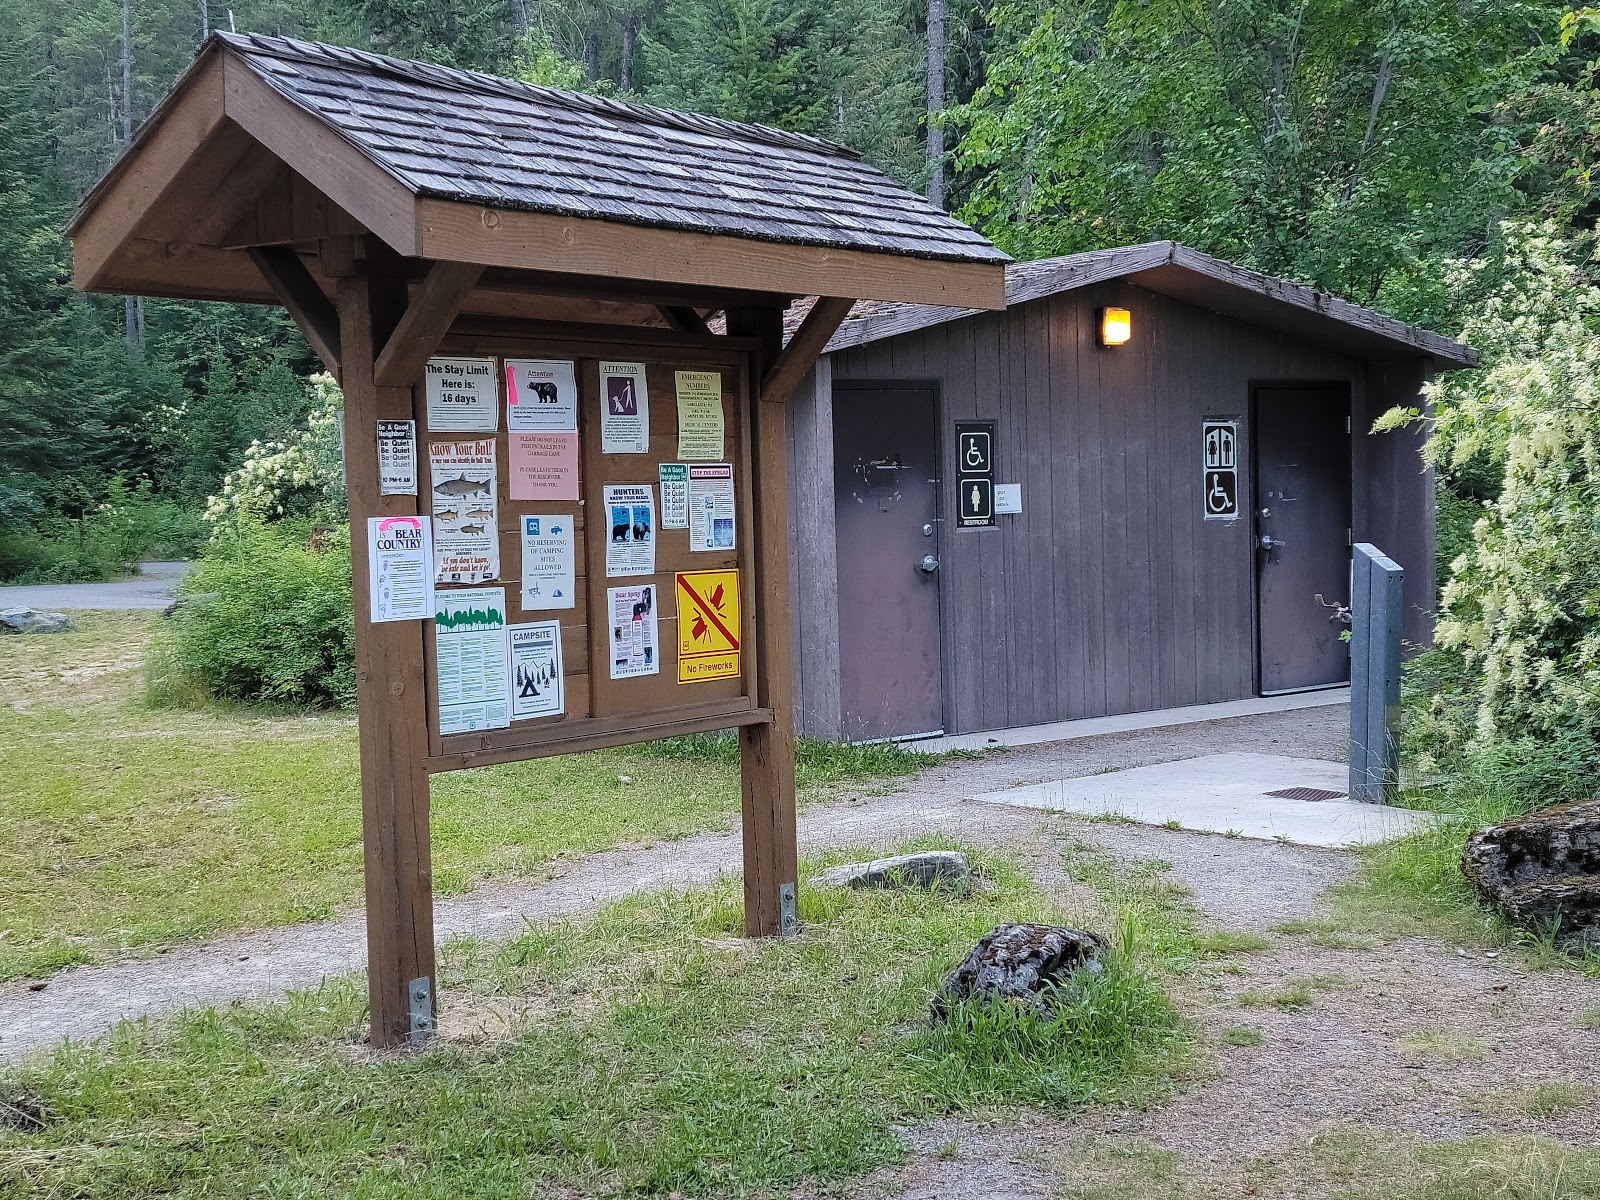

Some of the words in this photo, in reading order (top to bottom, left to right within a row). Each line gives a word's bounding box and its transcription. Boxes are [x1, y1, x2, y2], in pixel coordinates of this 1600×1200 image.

[426, 364, 442, 374] The
[445, 365, 464, 376] Stay
[466, 366, 489, 375] Limit
[603, 365, 638, 373] ATTENTION
[442, 379, 462, 388] Here
[465, 380, 475, 389] is:
[442, 393, 453, 403] 16
[455, 394, 477, 405] days
[430, 443, 451, 456] Know
[455, 442, 473, 456] Your
[475, 441, 492, 455] Bull!
[395, 529, 422, 538] BEAR
[377, 539, 422, 550] COUNTRY
[514, 631, 550, 640] CAMPSITE
[687, 665, 696, 673] No
[699, 661, 732, 672] Fireworks
